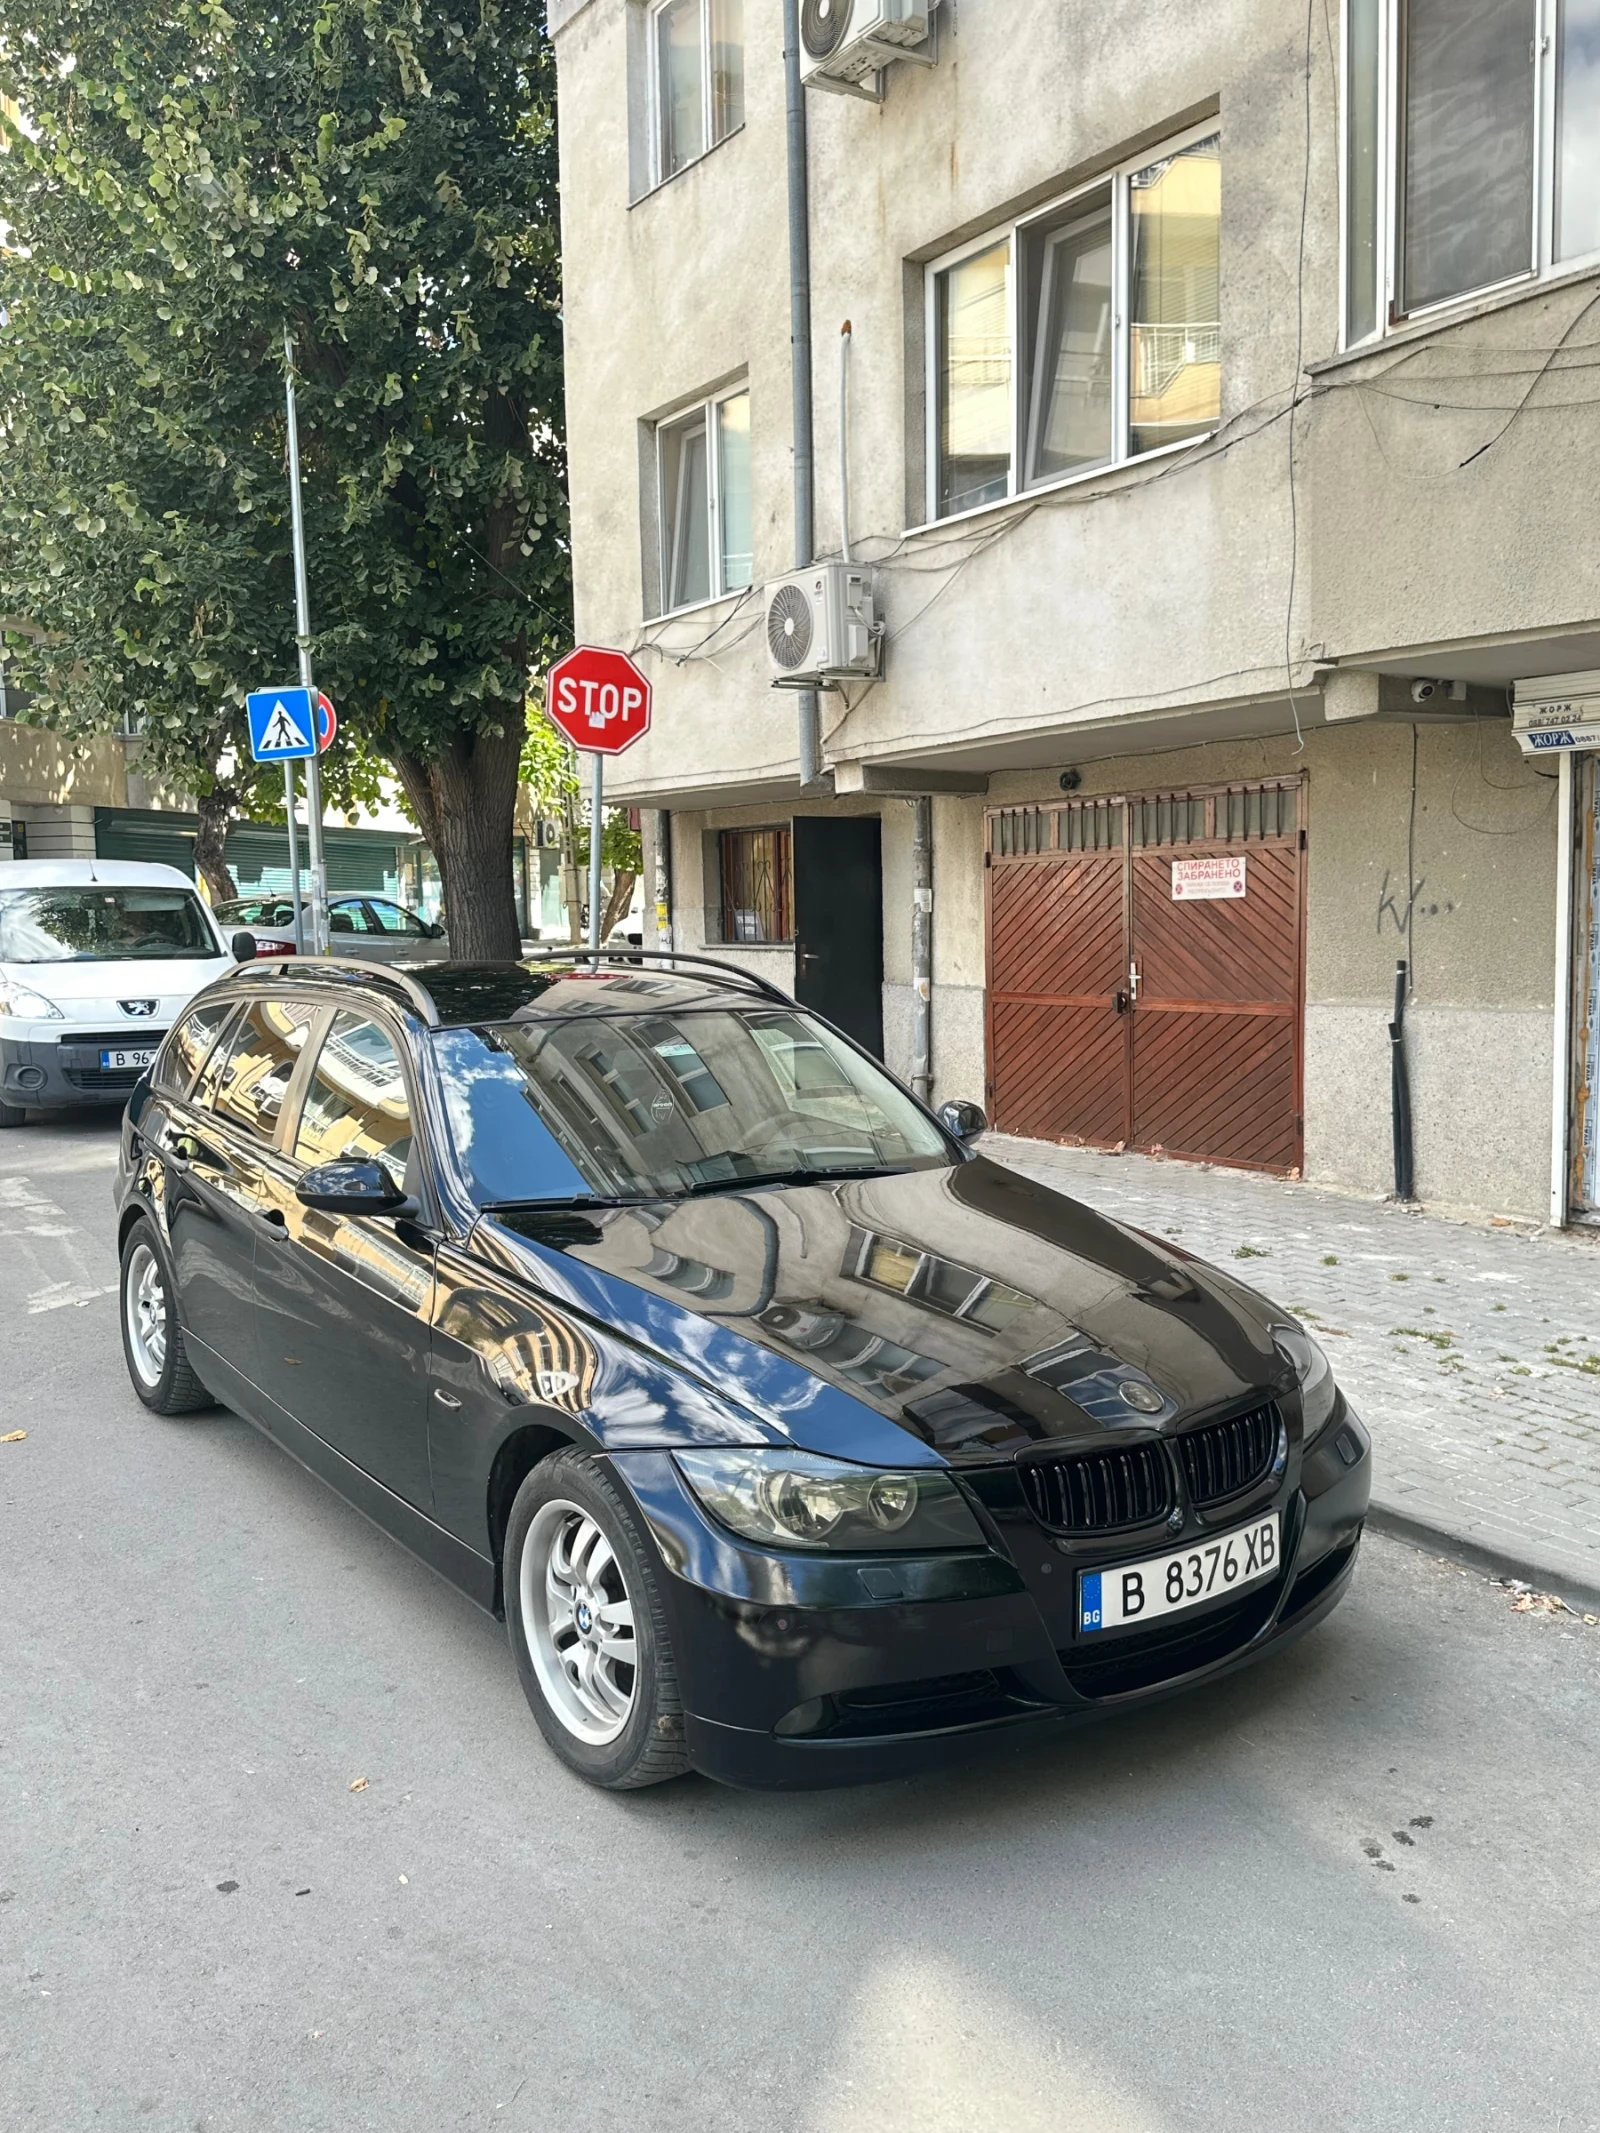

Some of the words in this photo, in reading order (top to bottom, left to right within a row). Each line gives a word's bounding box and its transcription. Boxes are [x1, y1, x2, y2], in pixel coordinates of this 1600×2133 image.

[557, 676, 643, 721] STOP
[1539, 704, 1572, 714] ЖОРЖ
[1546, 717, 1560, 726] 747
[1561, 716, 1570, 724] 02
[1532, 731, 1573, 747] ЖОРЖ
[1177, 858, 1240, 872] СПИРАНЕТО
[1177, 868, 1241, 881] ЗАБРАНЕНО
[116, 1053, 126, 1066] B
[1121, 1571, 1145, 1617] B
[1165, 1540, 1238, 1603] 8376
[1244, 1523, 1275, 1575] XB
[1083, 1609, 1100, 1625] BG
